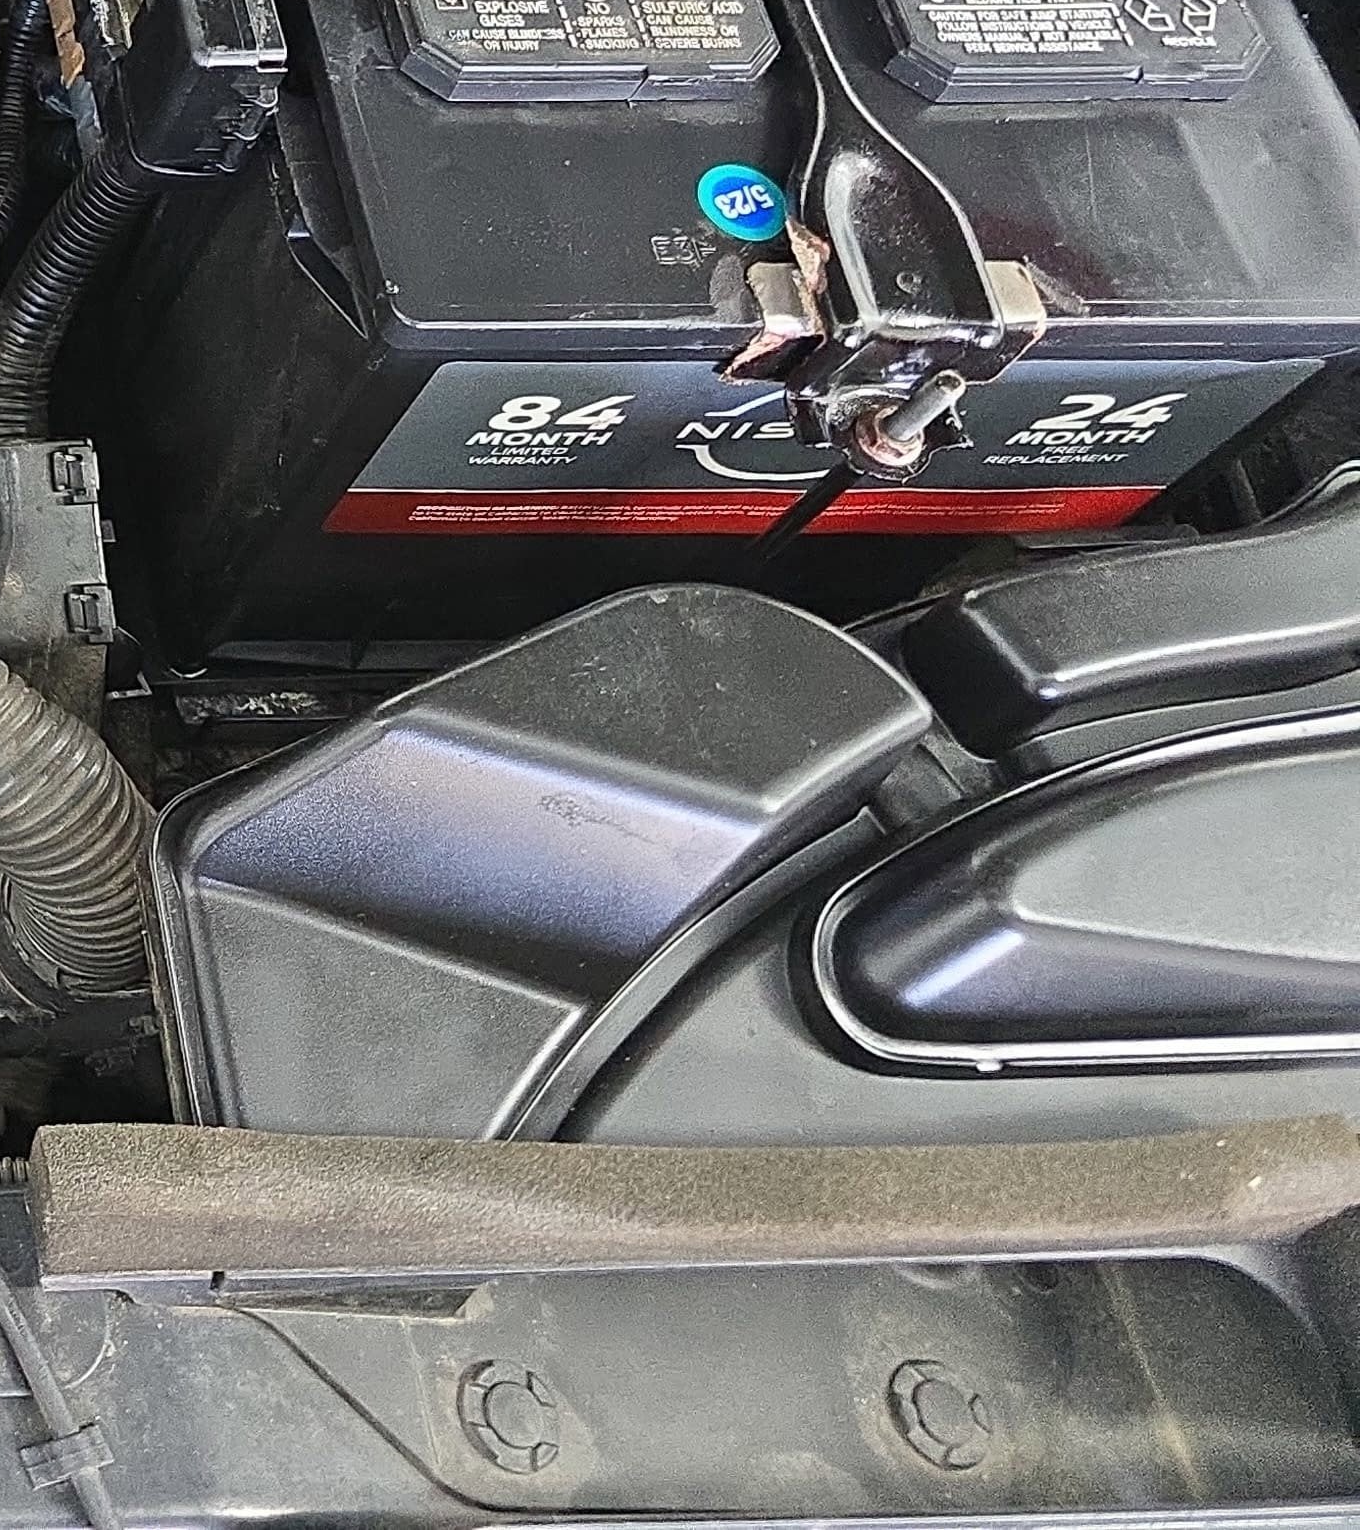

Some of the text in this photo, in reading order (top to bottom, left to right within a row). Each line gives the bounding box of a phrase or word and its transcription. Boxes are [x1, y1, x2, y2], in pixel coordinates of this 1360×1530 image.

[475, 1, 550, 14] EXPLOSIVE
[584, 3, 611, 15] NO
[641, 1, 745, 15] SULFURIC ACID
[480, 15, 525, 27] GASES
[646, 15, 715, 26] CAN CAUSE
[976, 11, 999, 21] FOR
[1000, 11, 1028, 20] SAFE
[1030, 10, 1057, 20] JUMP
[650, 26, 739, 37] BLINDNESS OR
[936, 21, 979, 32] FOLLOW
[980, 21, 1054, 32] INSTRUCTIONS
[1055, 21, 1068, 31] IN
[448, 29, 470, 40] CAN
[471, 29, 507, 40] CAUSE
[1042, 32, 1065, 41] NOT
[483, 40, 540, 51] OR INJURY
[655, 38, 701, 49] SEVERE
[1161, 36, 1217, 47] RECYCLE
[993, 42, 1037, 53] SERVICE
[714, 184, 775, 219] 5/23
[488, 394, 636, 431] 84
[1030, 393, 1188, 430] 24
[676, 421, 795, 439] NIS
[465, 431, 614, 446] MONTH
[1005, 430, 1156, 446] MONTH
[490, 447, 569, 455] LIMITED
[1041, 445, 1093, 454] FREE
[468, 456, 578, 465] WARRANTY
[983, 454, 1129, 464] REPLACEMENT
